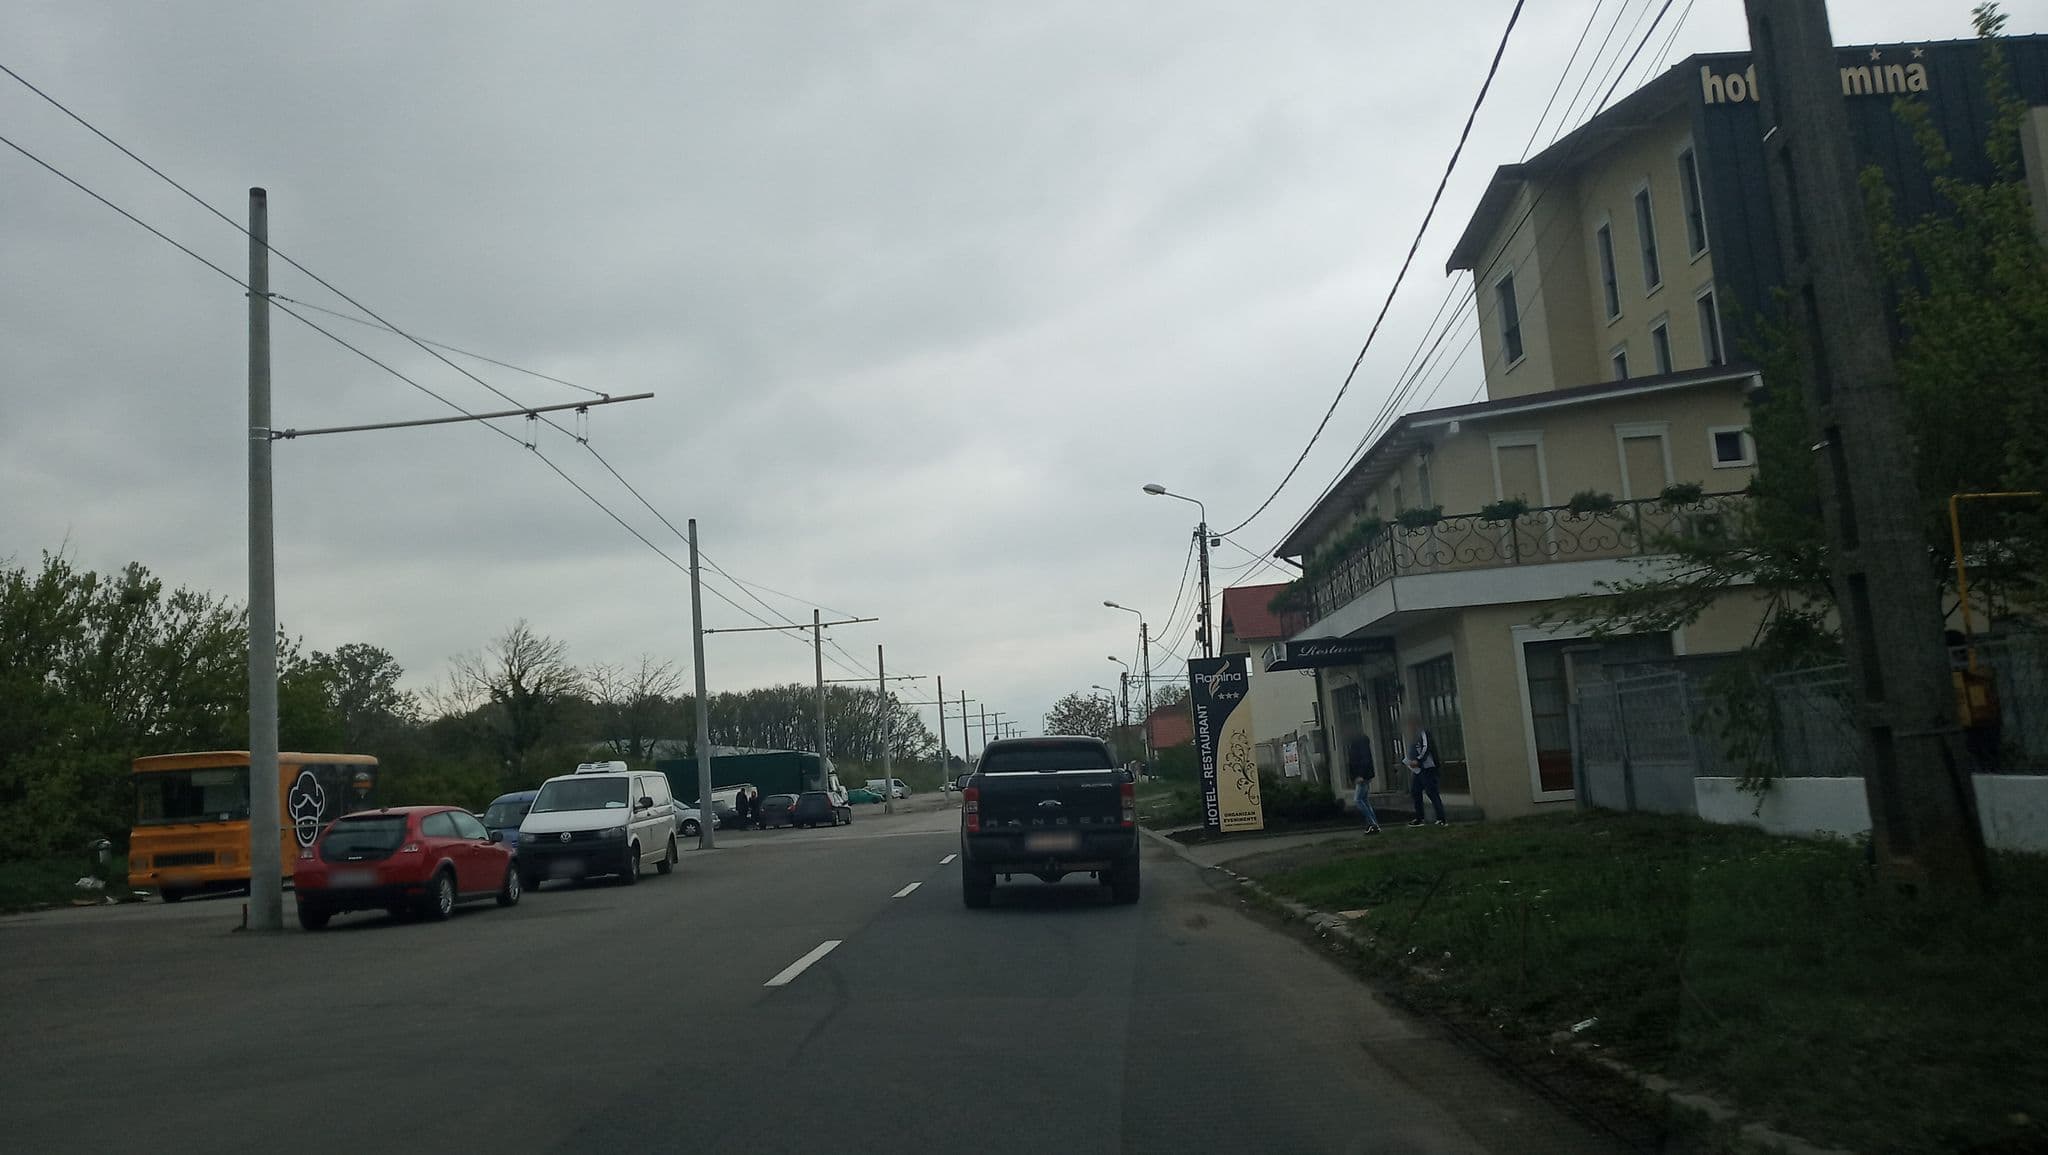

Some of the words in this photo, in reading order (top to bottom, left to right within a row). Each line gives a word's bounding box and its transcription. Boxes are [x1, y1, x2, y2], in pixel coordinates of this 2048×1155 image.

[1701, 64, 1760, 105] hot
[1840, 57, 1929, 96] mina
[1195, 672, 1241, 684] Ramina
[1197, 704, 1213, 779] RESTAURANT
[986, 816, 1115, 827] RANGER
[1206, 787, 1219, 826] HOTEL
